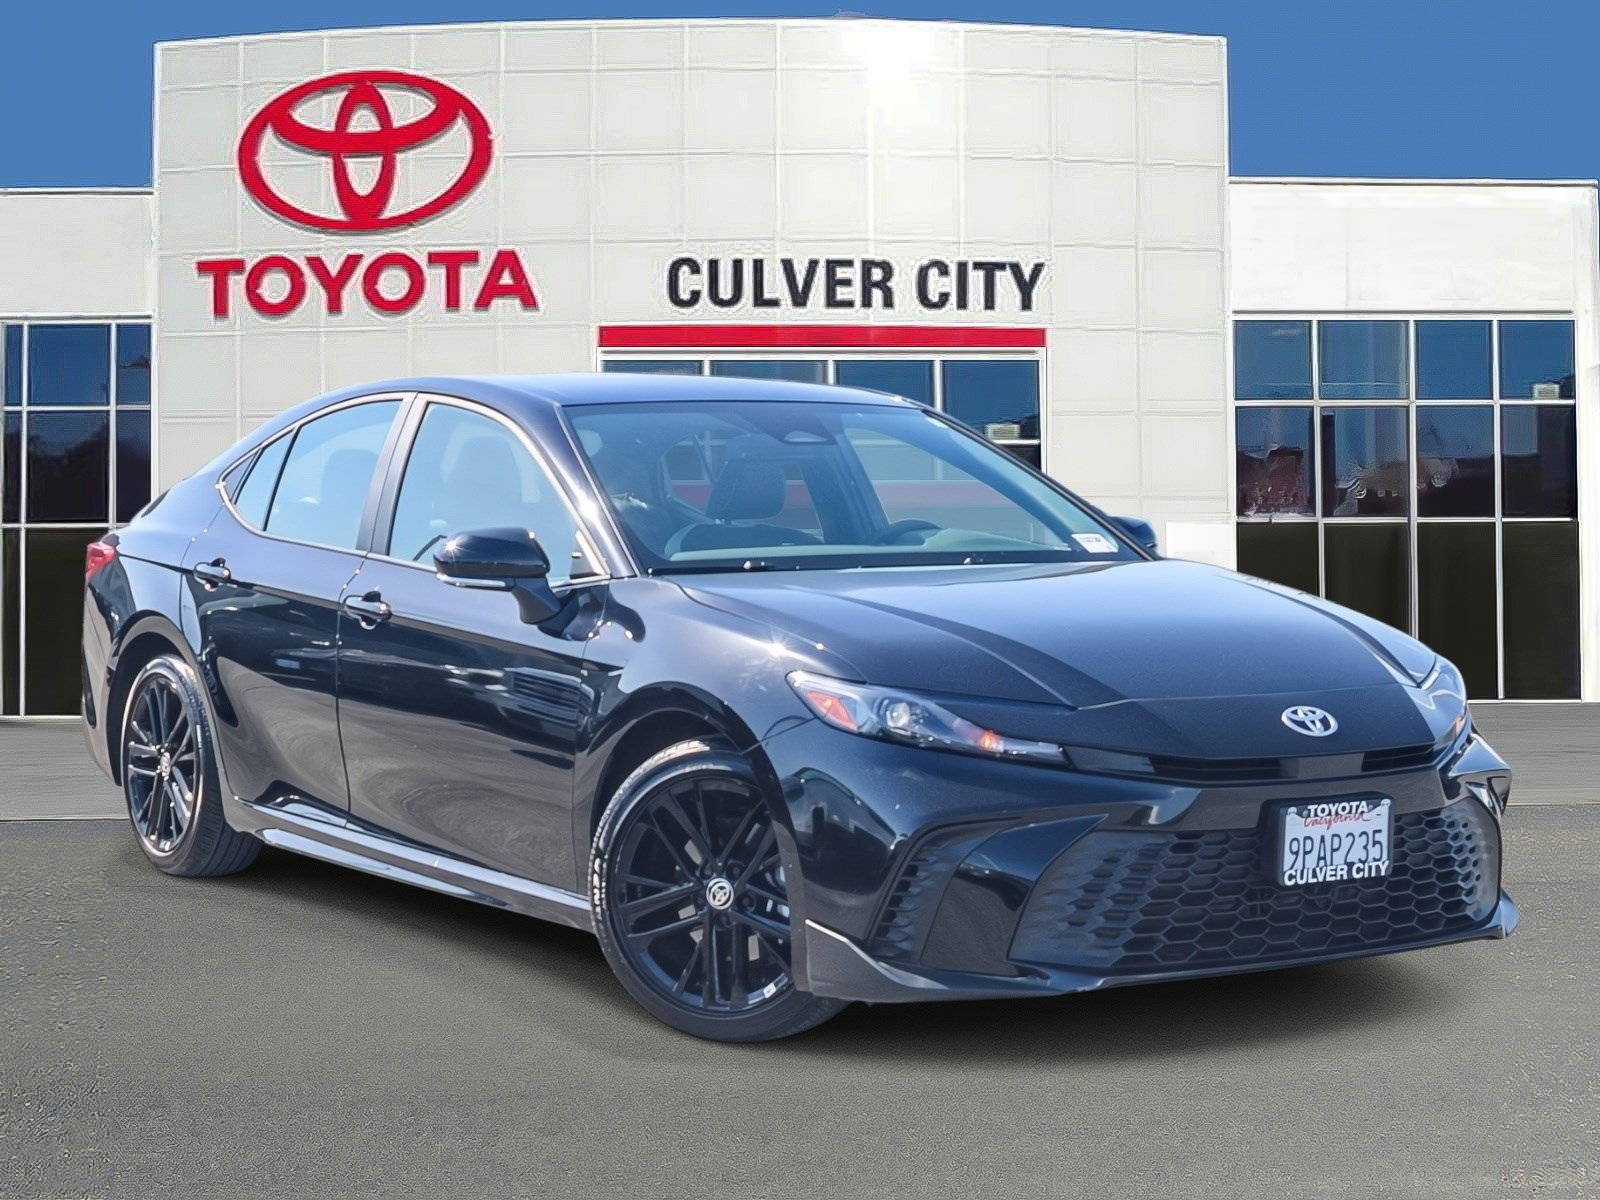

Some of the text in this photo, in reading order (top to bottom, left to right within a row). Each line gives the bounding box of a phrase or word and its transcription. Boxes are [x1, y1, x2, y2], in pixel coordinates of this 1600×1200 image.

[195, 249, 537, 317] TOYOTA
[667, 257, 1045, 311] CULVER CITY
[1307, 801, 1369, 818] TOYOTA
[1288, 829, 1384, 870] 9PAP235
[1283, 860, 1389, 886] CULVER CITY
